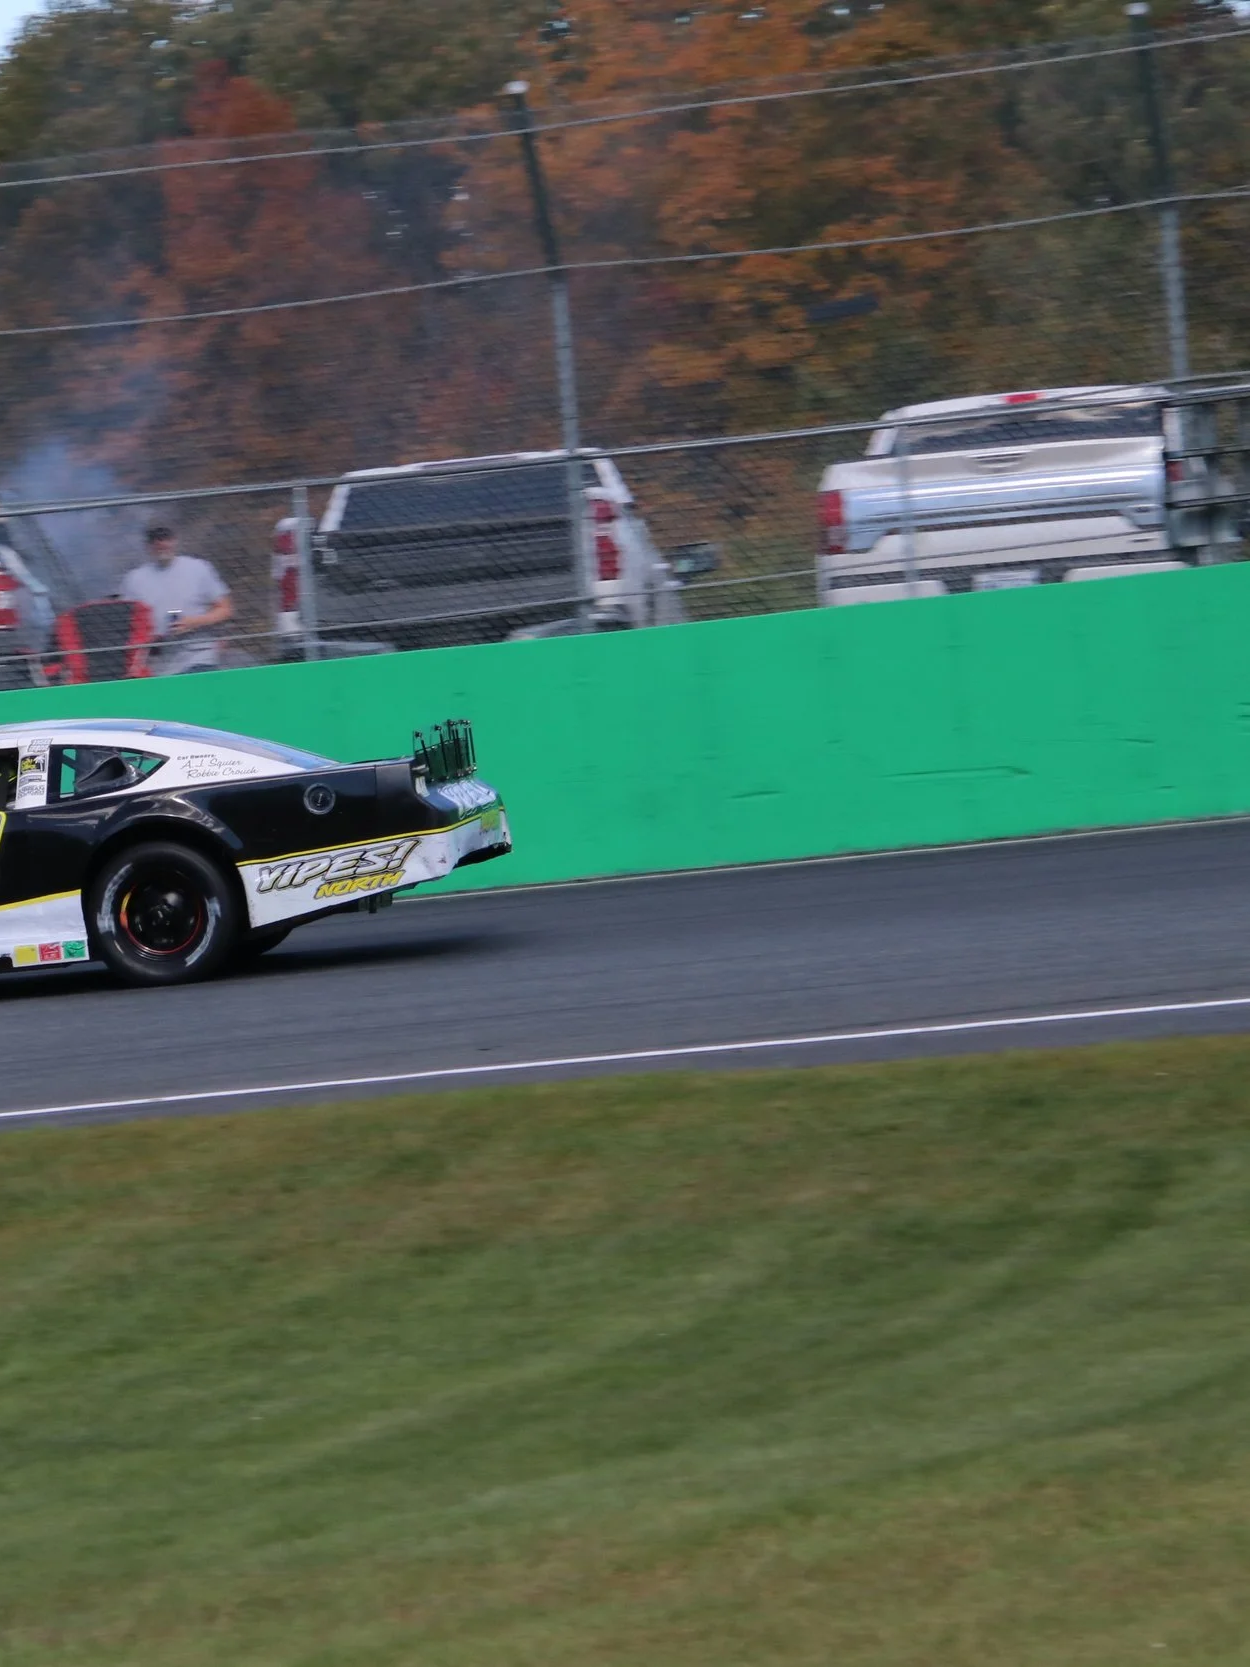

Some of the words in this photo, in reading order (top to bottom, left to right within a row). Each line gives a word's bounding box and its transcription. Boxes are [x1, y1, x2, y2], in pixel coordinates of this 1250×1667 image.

[186, 768, 219, 779] Robbie
[222, 766, 259, 776] Crouch
[256, 837, 422, 894] YIPES!
[313, 870, 406, 899] NORTH
